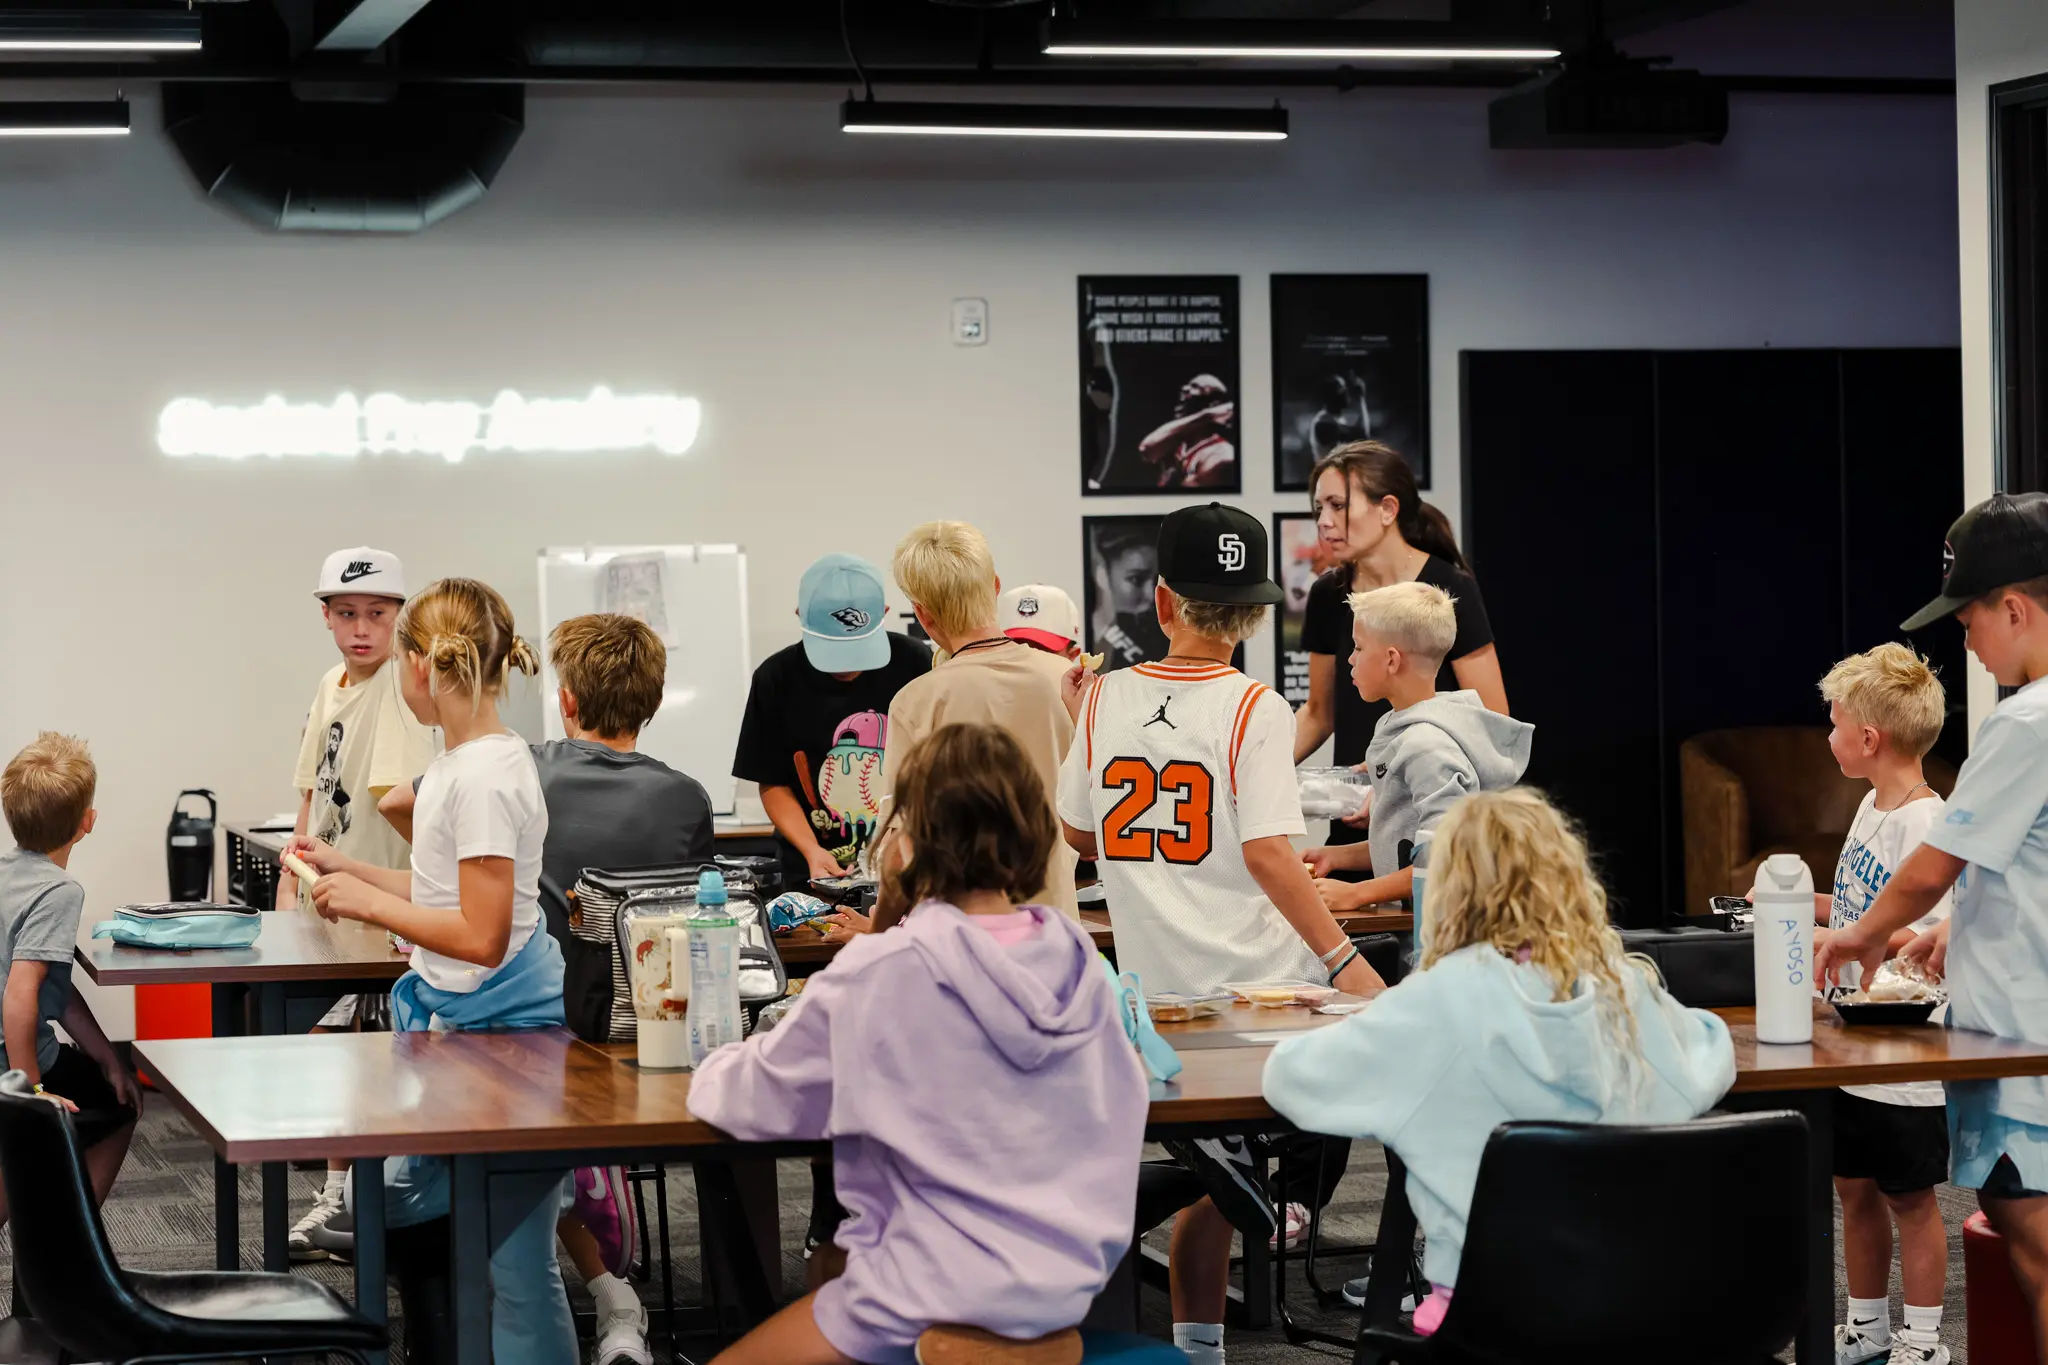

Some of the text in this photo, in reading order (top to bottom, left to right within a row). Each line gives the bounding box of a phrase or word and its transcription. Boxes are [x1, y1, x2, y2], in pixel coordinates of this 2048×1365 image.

[346, 561, 373, 574] NIKE
[1218, 533, 1246, 572] SD
[1104, 624, 1144, 662] UFC
[1102, 756, 1214, 865] 23
